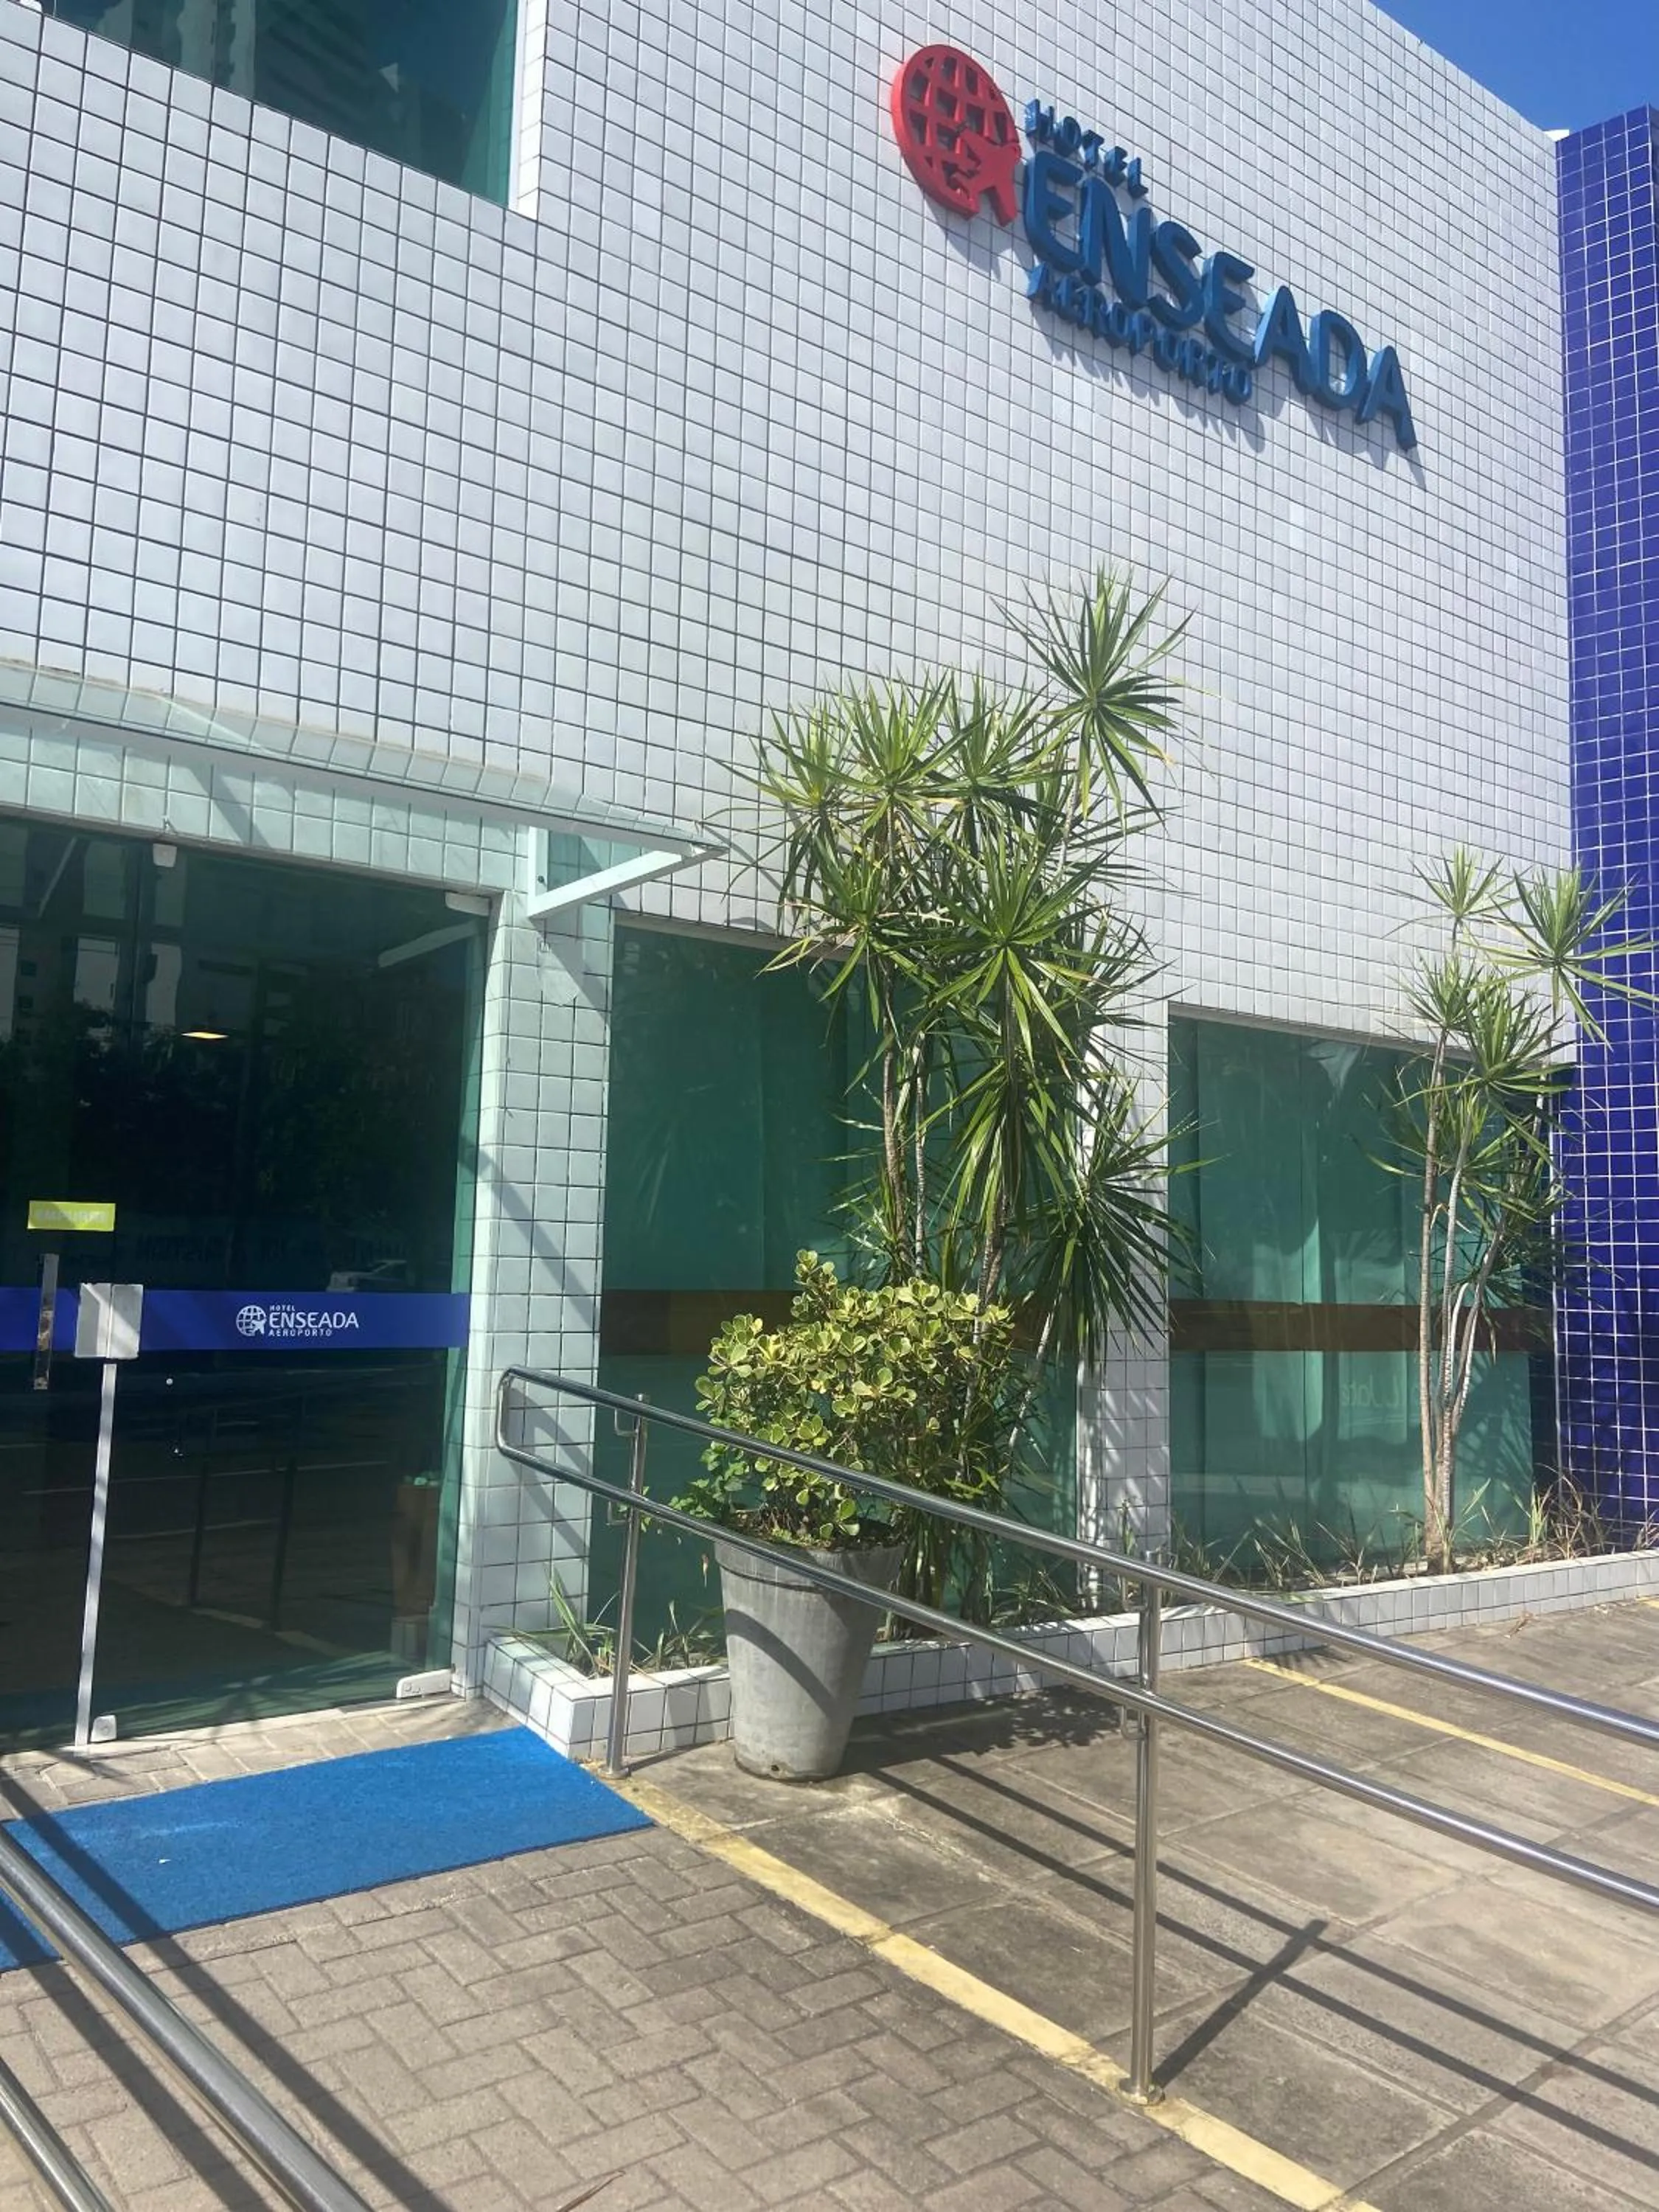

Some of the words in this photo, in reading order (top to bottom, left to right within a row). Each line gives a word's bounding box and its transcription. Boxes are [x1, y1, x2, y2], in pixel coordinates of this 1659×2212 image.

[1023, 98, 1148, 198] HOTEL
[1023, 150, 1417, 451] ENSEADA
[1026, 262, 1253, 406] AEROPORTO
[269, 1312, 359, 1329] ENSEADA
